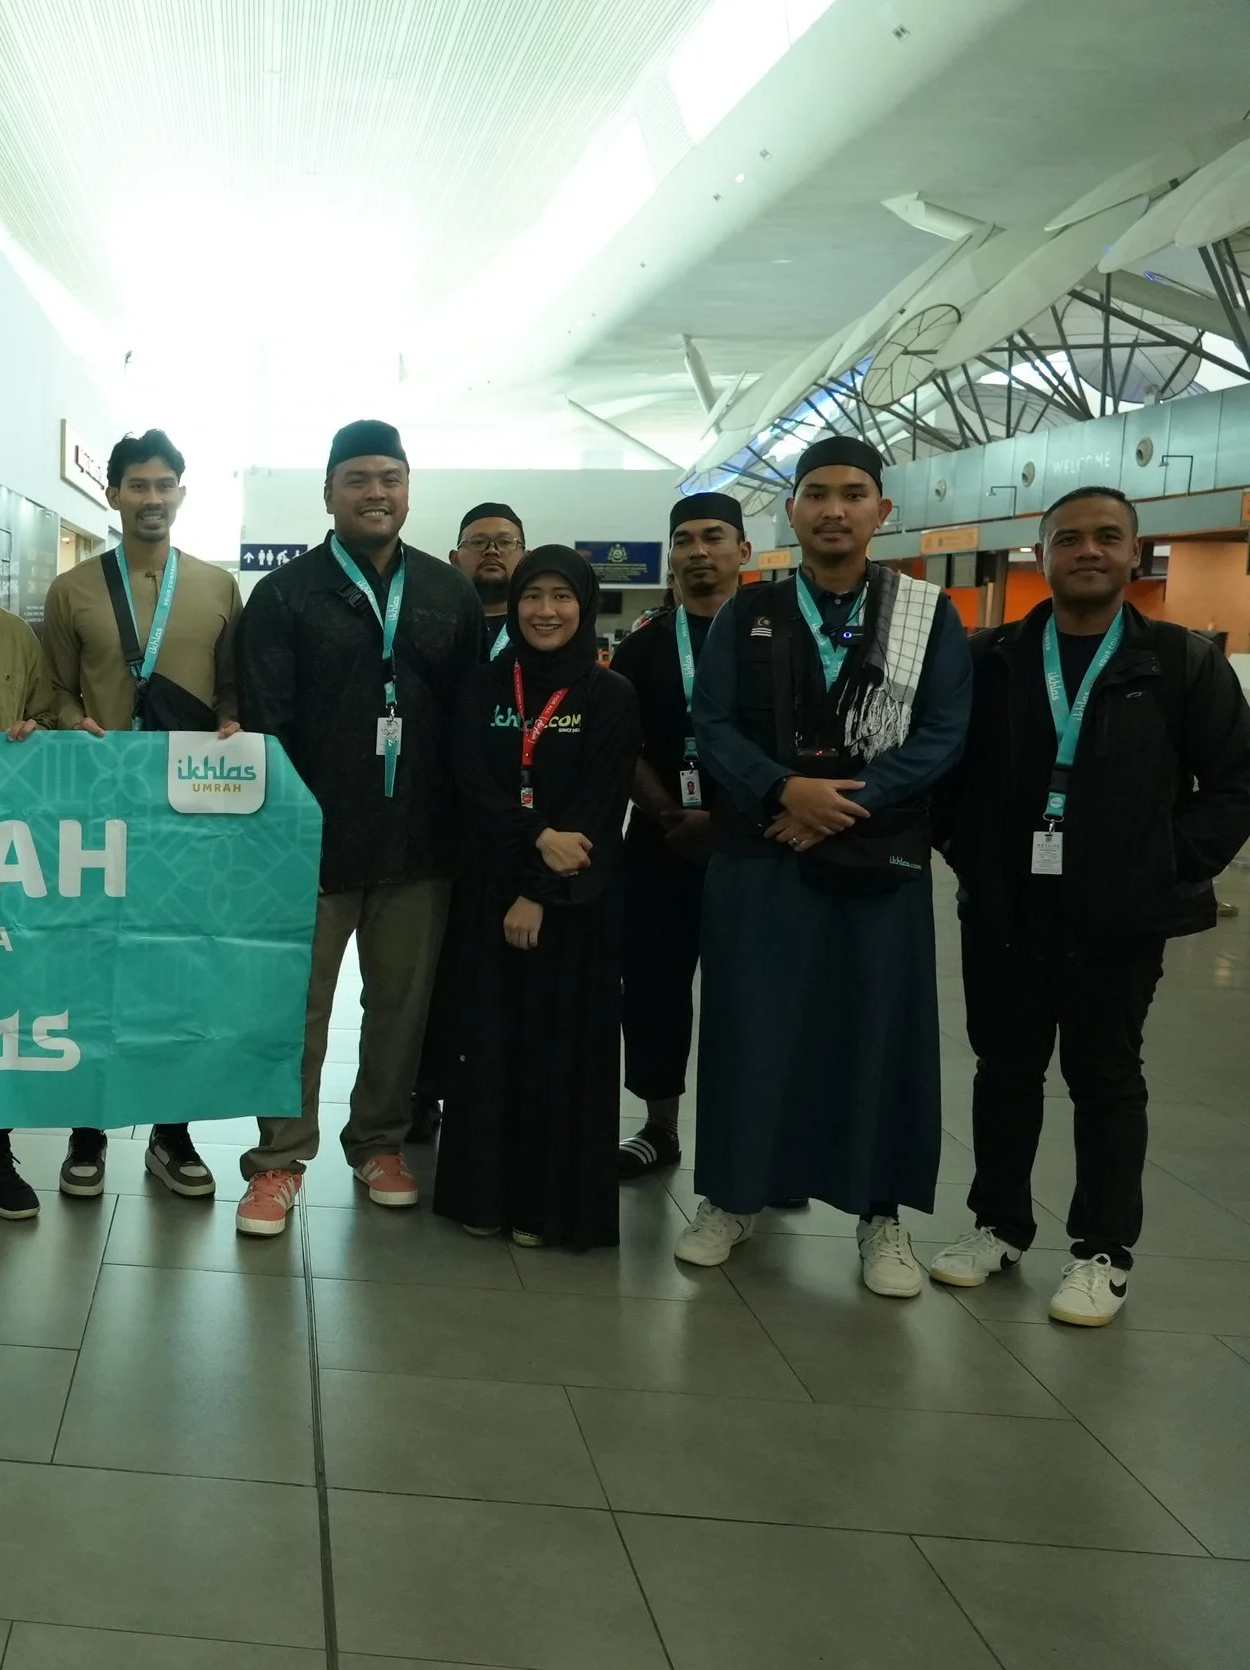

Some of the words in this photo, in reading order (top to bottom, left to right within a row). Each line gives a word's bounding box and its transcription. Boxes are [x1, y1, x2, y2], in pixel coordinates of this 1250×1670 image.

[1052, 451, 1111, 475] WELCOME
[149, 627, 163, 655] ikhlas
[1047, 671, 1060, 701] ikhlas
[176, 755, 258, 783] ikhlas
[192, 782, 242, 793] UMRAH
